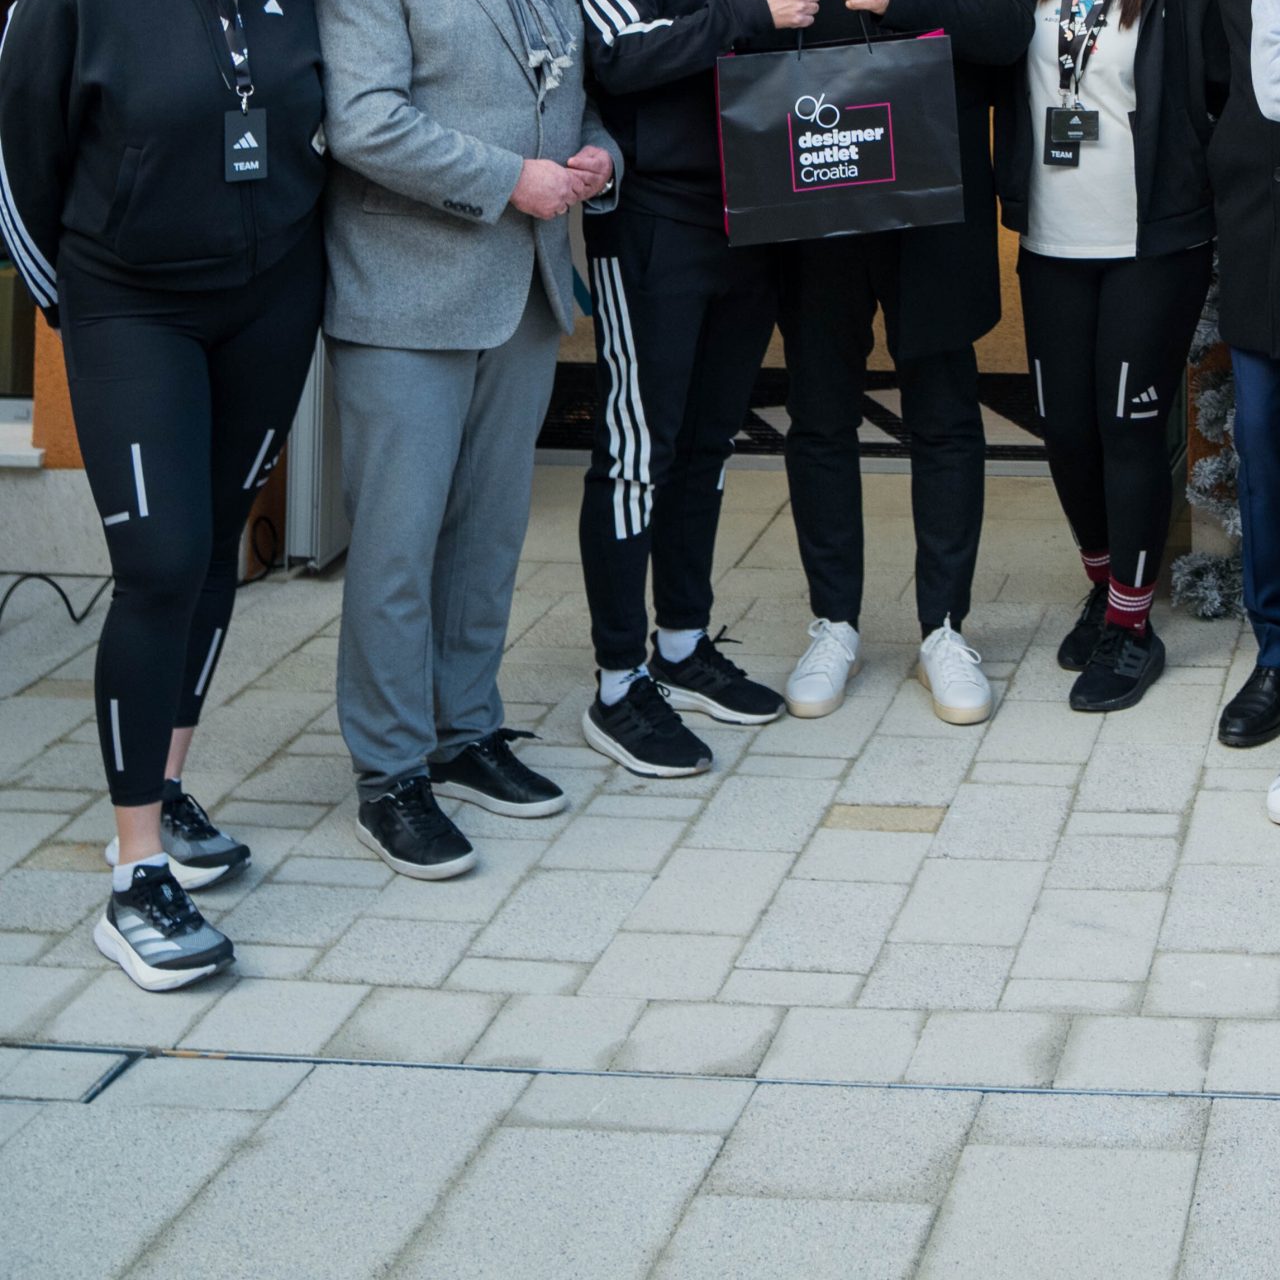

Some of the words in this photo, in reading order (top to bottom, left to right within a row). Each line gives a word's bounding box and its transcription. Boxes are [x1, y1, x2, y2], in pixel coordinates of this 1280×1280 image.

[798, 126, 884, 148] designer
[799, 145, 859, 166] outlet
[1051, 150, 1073, 159] TEAM
[233, 161, 260, 171] TEAM
[801, 163, 858, 183] Croatia
